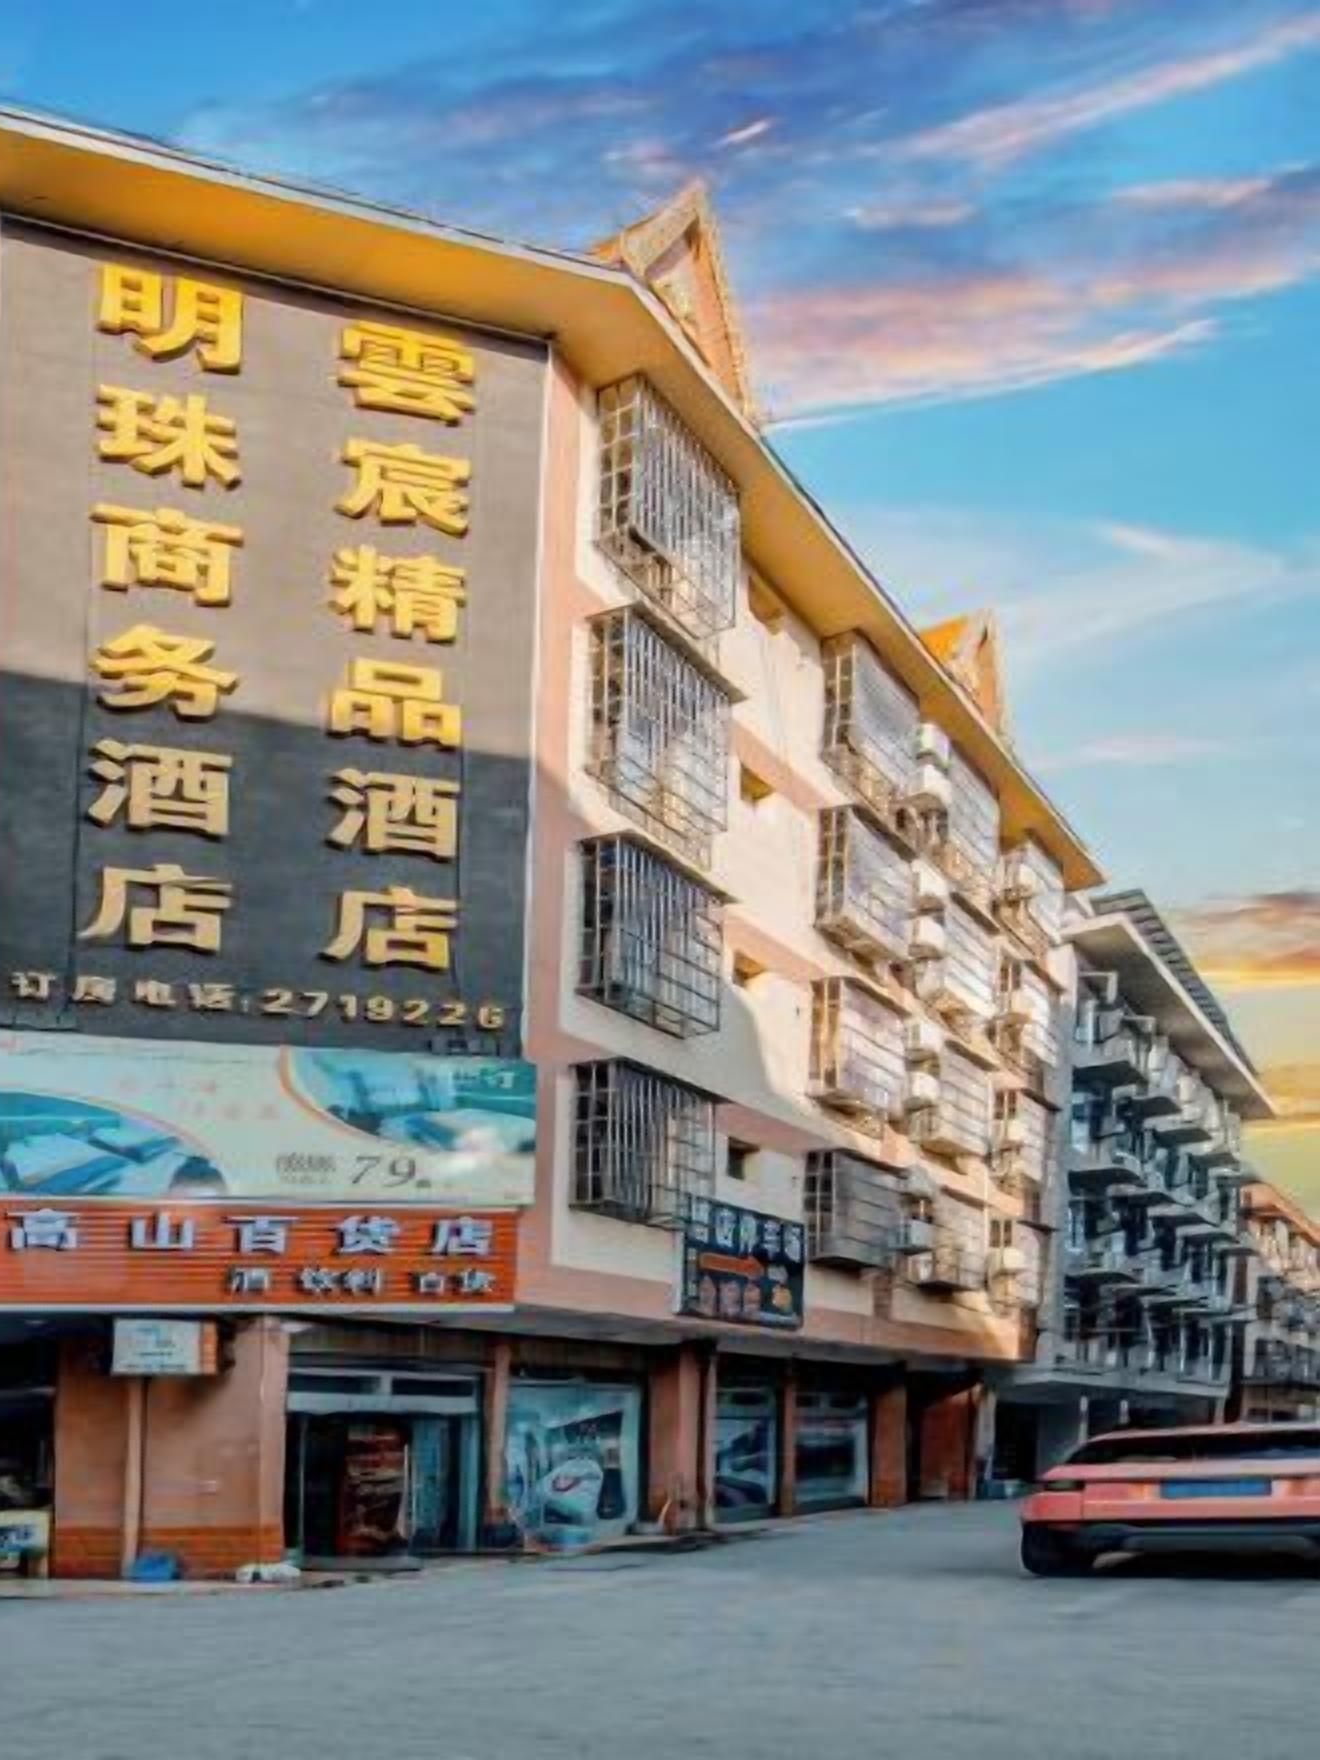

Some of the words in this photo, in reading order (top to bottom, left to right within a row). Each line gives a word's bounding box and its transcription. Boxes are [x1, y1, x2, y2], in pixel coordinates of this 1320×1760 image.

[80, 262, 244, 955] 明珠商务酒店
[320, 320, 476, 972] 雲宸精品酒店
[5, 1208, 495, 1256] 高山百货店
